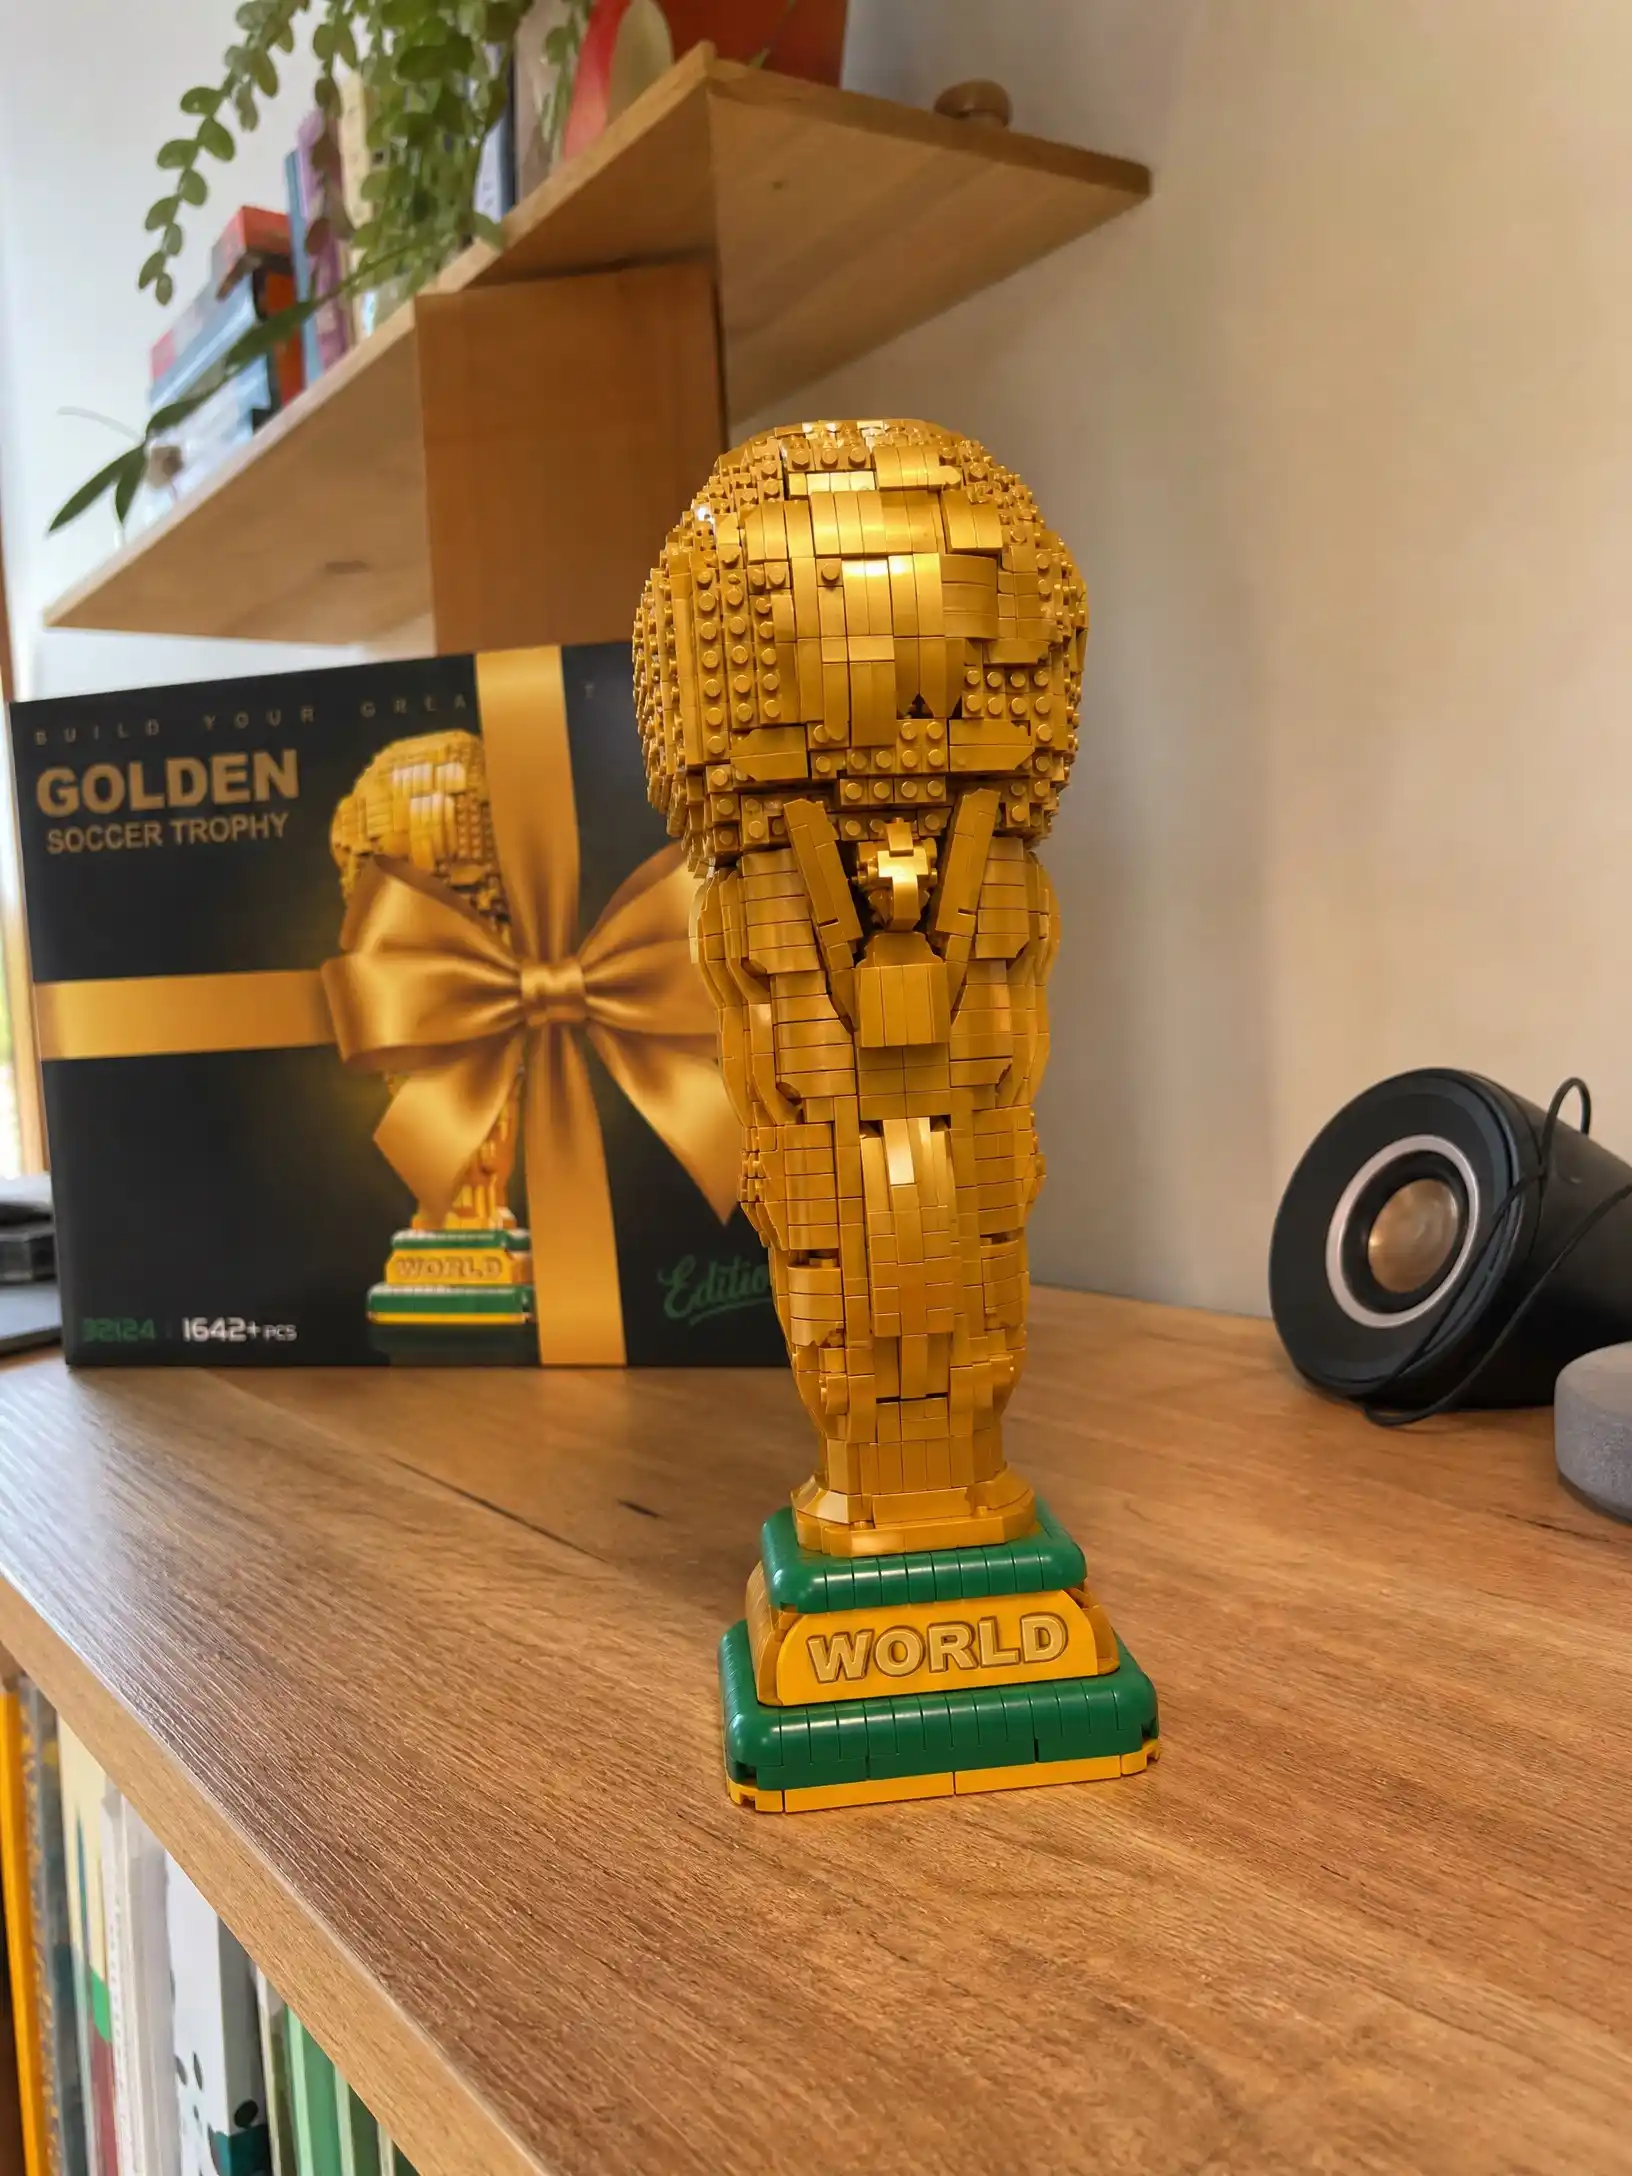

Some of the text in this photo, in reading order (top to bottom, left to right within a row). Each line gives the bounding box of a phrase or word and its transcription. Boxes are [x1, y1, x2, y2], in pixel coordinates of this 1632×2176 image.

[35, 718, 160, 746] BUILD
[203, 705, 314, 731] YOUR
[36, 749, 299, 818] GOLDEN
[47, 812, 289, 855] SOCCER TROPHY
[396, 1255, 503, 1280] WORLD
[181, 1316, 261, 1342] 1642+
[806, 1612, 1069, 1685] WORLD
